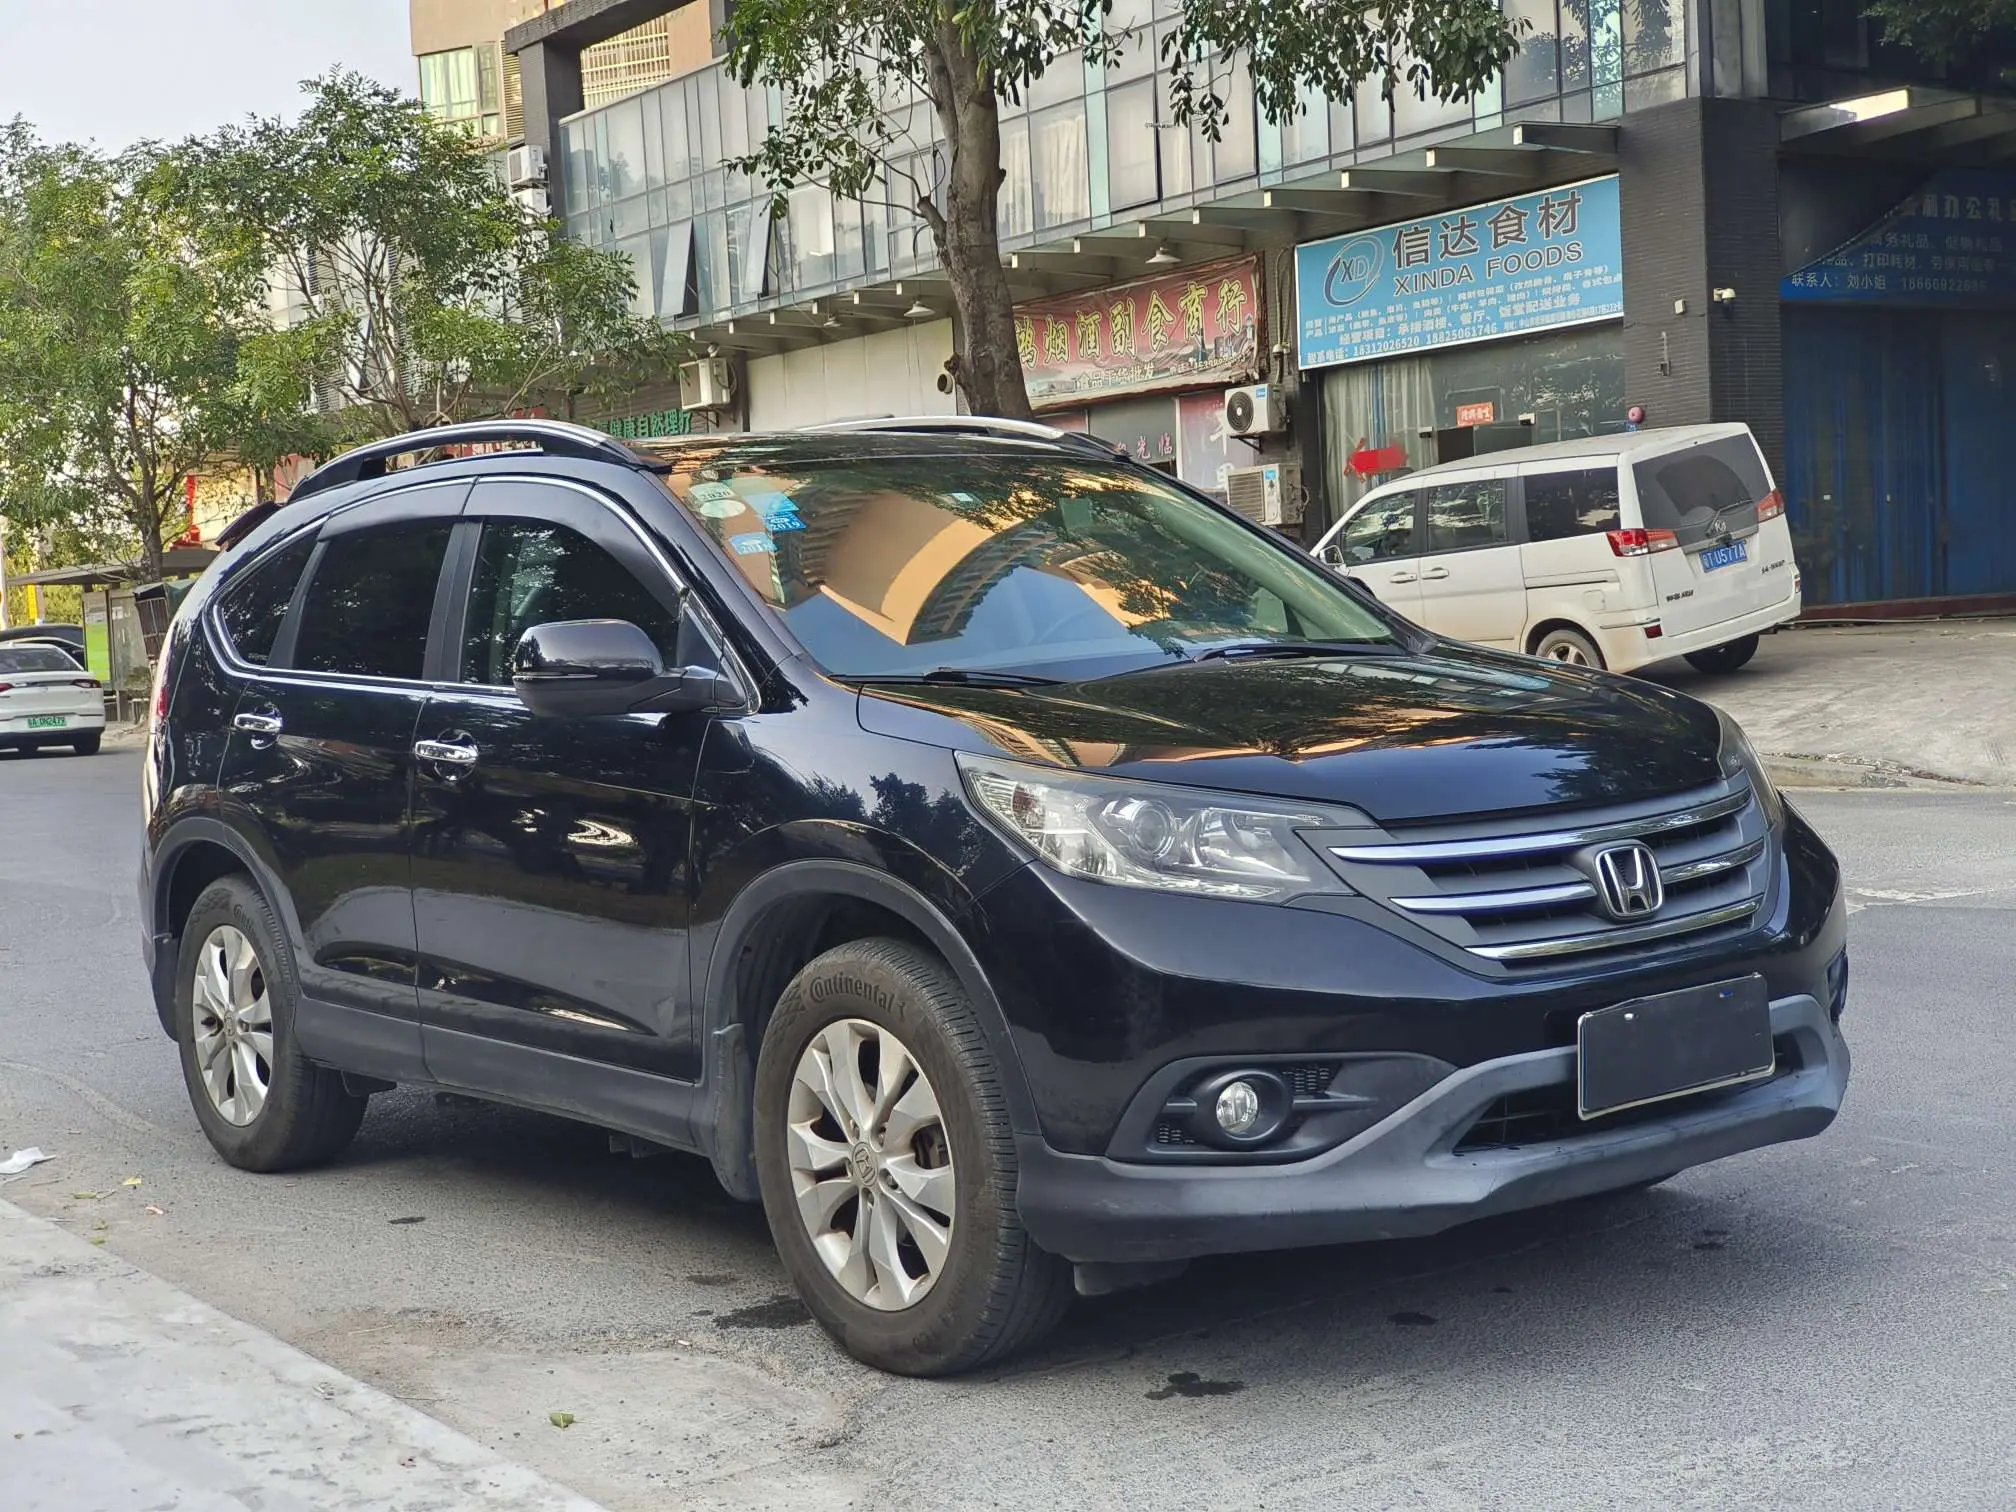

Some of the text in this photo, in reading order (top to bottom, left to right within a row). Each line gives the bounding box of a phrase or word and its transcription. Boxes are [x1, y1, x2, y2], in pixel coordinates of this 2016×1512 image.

[1393, 190, 1582, 269] 信达食材
[1393, 264, 1474, 297] XINDA
[1485, 241, 1584, 280] FOODS
[809, 972, 896, 1013] Continental
